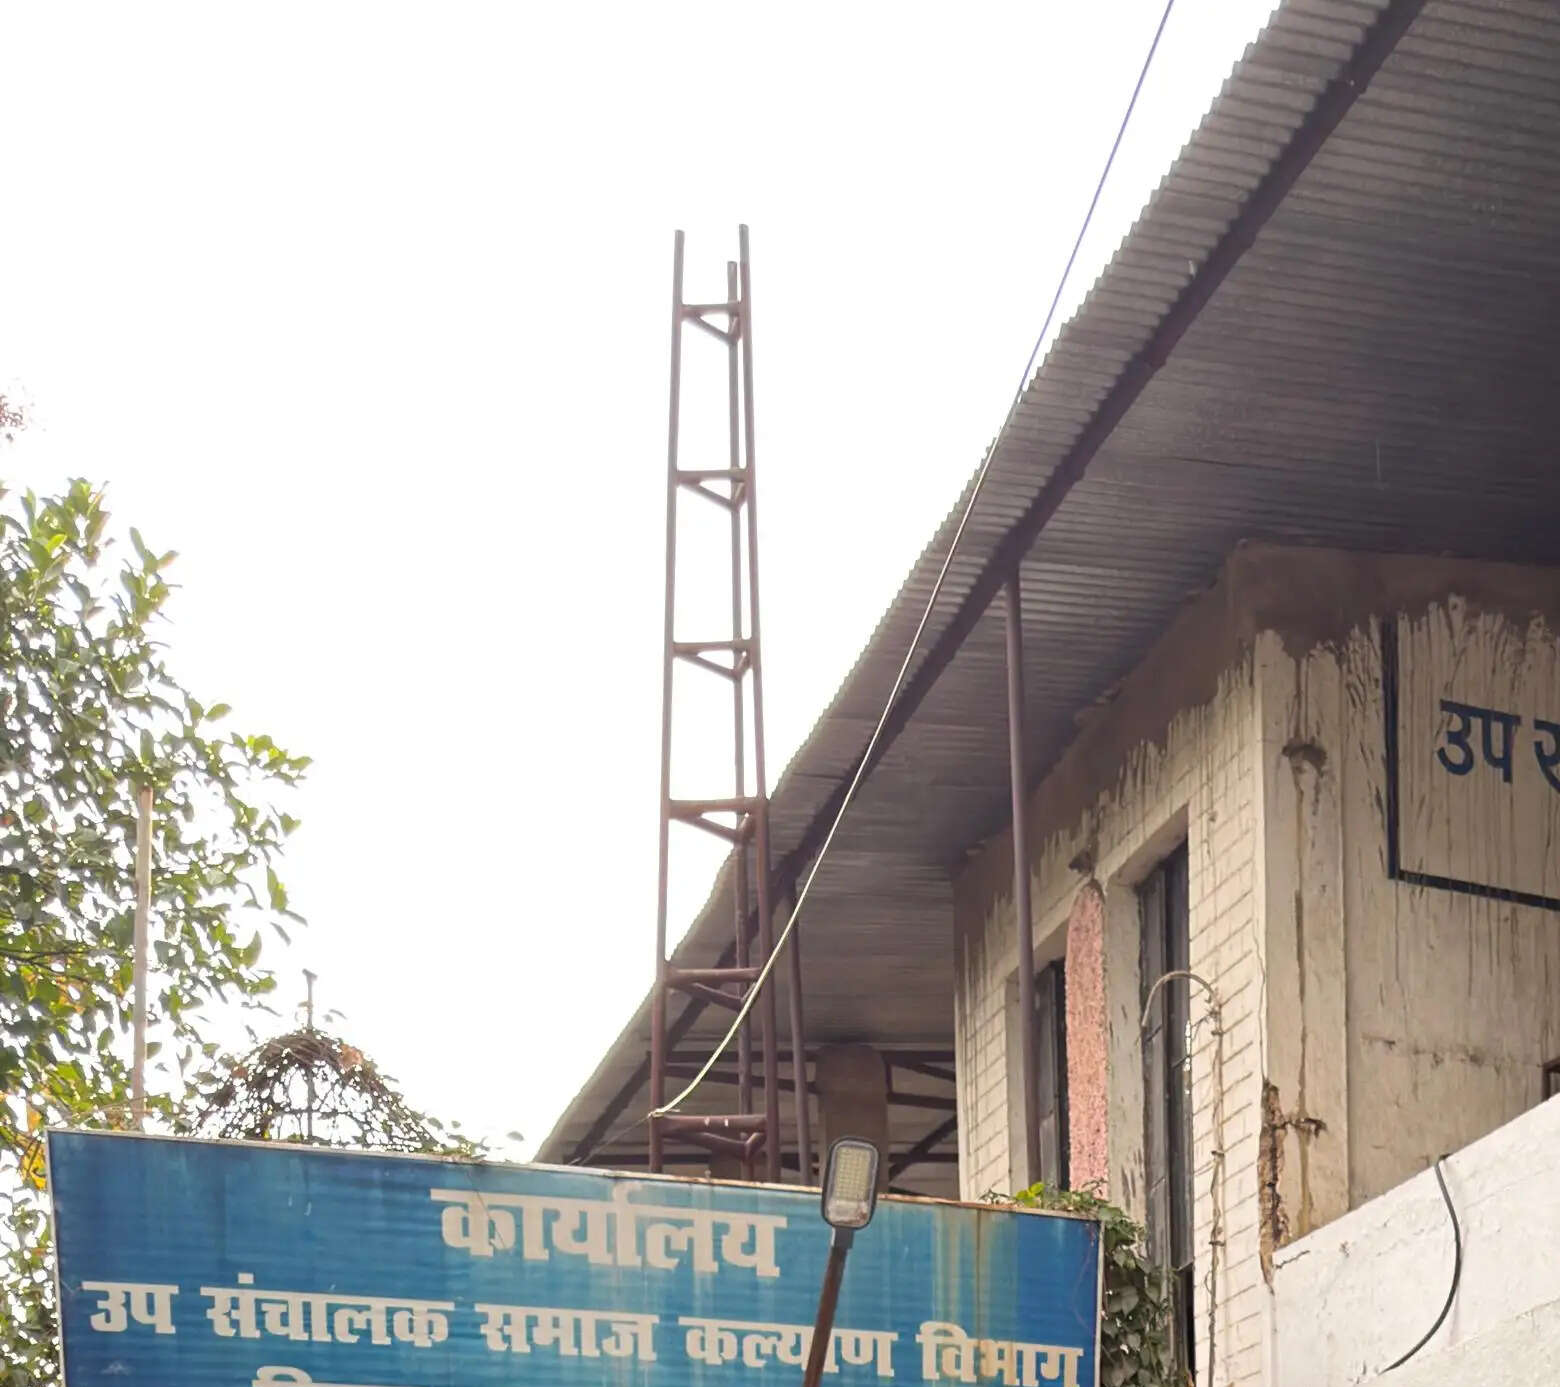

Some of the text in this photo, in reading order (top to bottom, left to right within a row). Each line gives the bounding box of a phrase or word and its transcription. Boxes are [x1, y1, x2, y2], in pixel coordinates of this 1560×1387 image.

[1437, 699, 1521, 783] उप
[430, 1181, 788, 1277] कार्यालय
[81, 1280, 179, 1334] उप
[199, 1272, 455, 1347] संचालक
[475, 1303, 660, 1361] समाज
[678, 1316, 898, 1377] कल्याण
